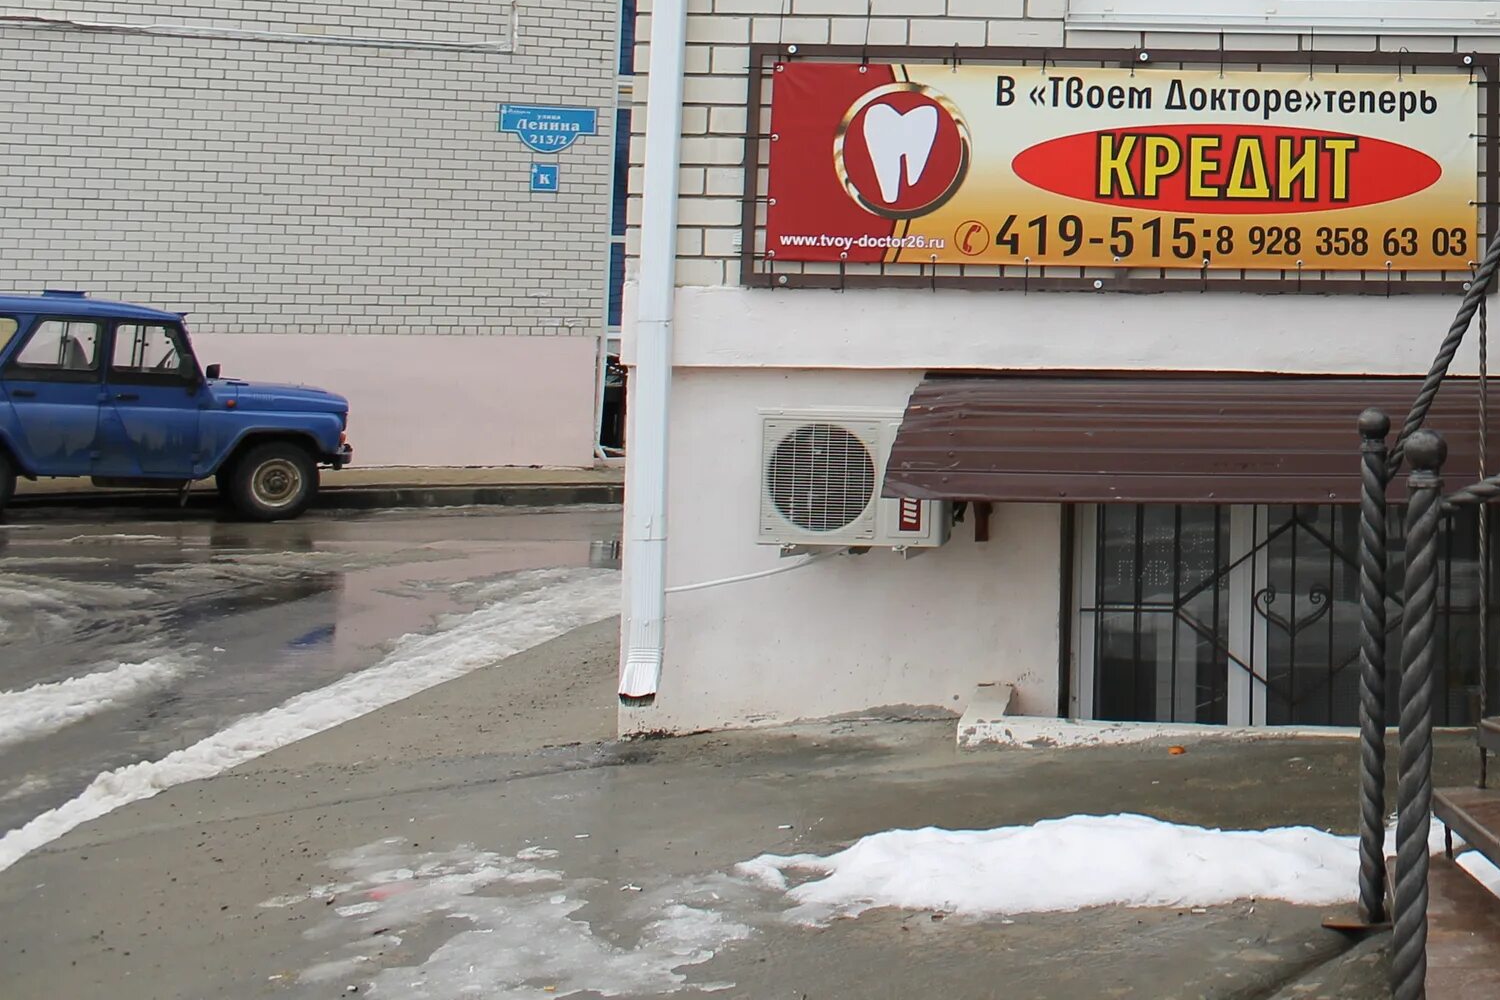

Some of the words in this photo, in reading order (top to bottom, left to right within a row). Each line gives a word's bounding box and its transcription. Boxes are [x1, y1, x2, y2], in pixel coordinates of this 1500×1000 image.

[996, 75, 1016, 107] В
[516, 118, 580, 132] Ленина
[1095, 130, 1361, 203] КРЕДИТ
[539, 173, 551, 185] К
[780, 233, 945, 250] www.tvoy-doctor26.ru
[1248, 226, 1302, 256] 928
[1316, 227, 1369, 257] 358
[1382, 227, 1418, 257] 63
[1432, 227, 1467, 257] 03
